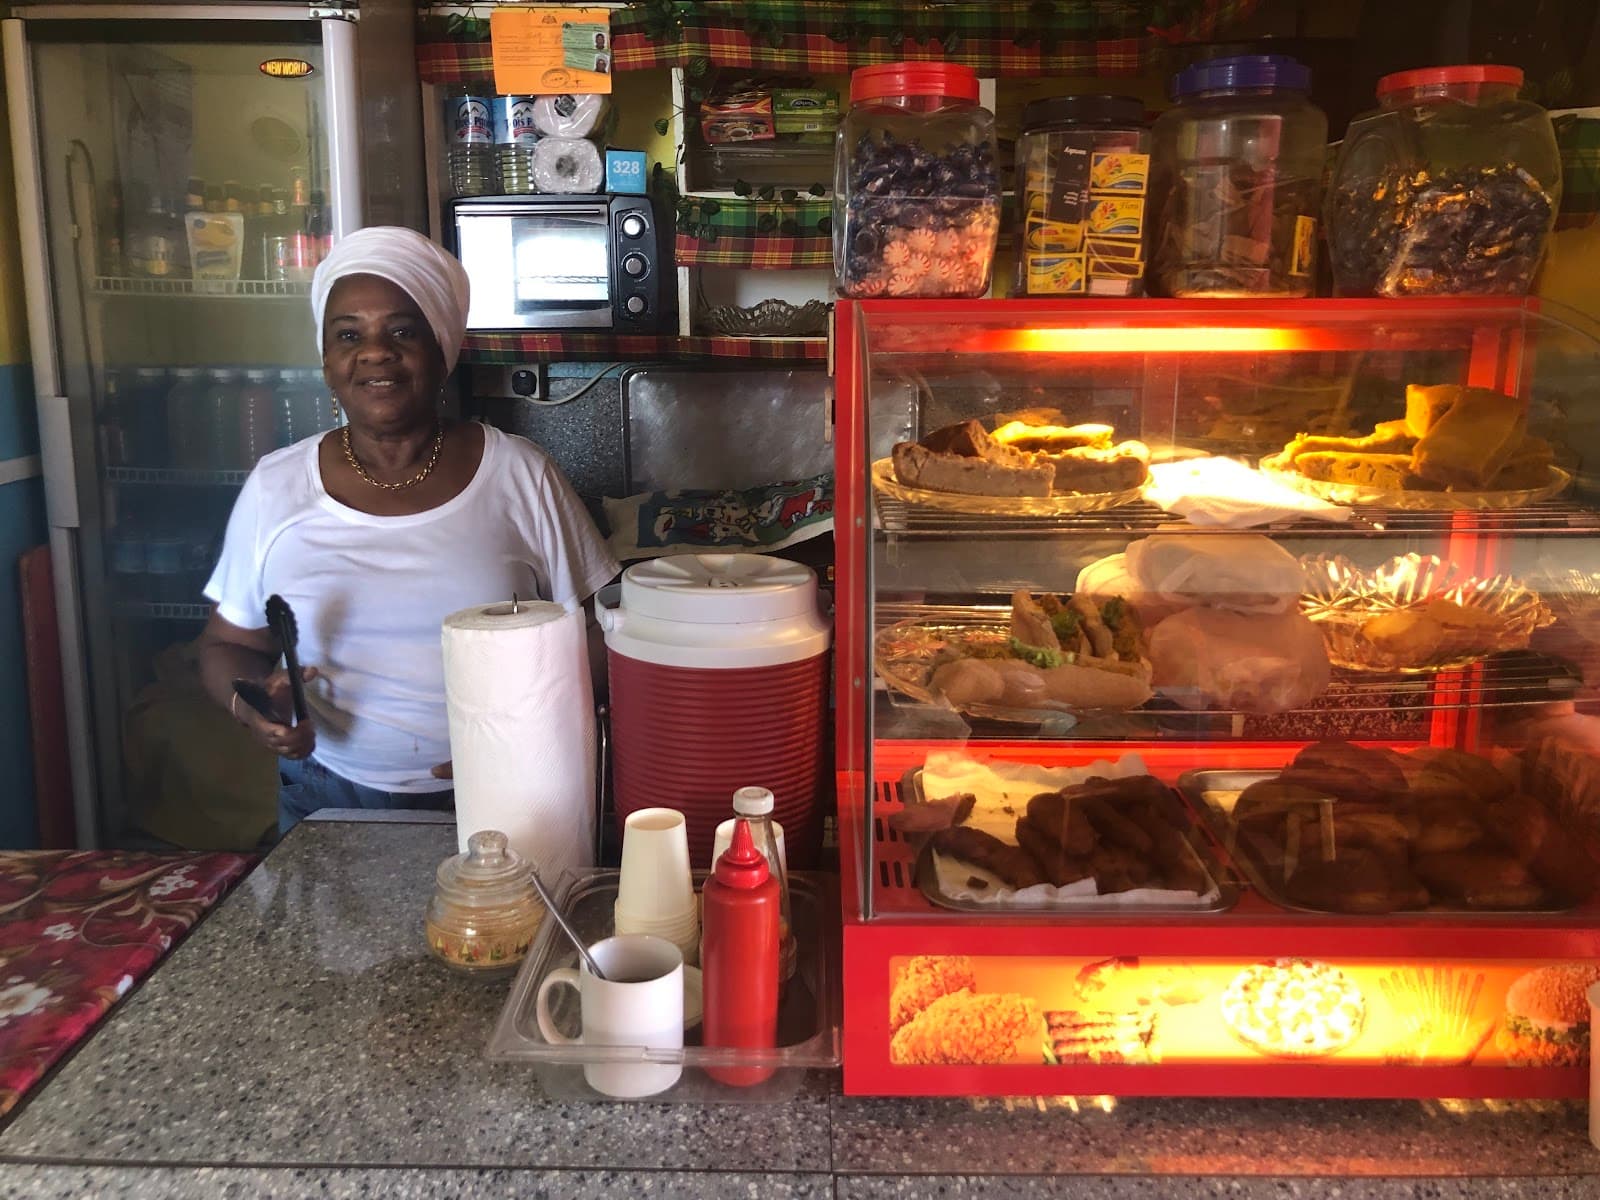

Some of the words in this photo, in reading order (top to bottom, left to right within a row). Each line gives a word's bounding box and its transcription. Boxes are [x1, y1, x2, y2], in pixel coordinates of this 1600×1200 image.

[266, 61, 282, 75] NEW
[282, 61, 308, 75] WORLD
[613, 160, 640, 174] 328
